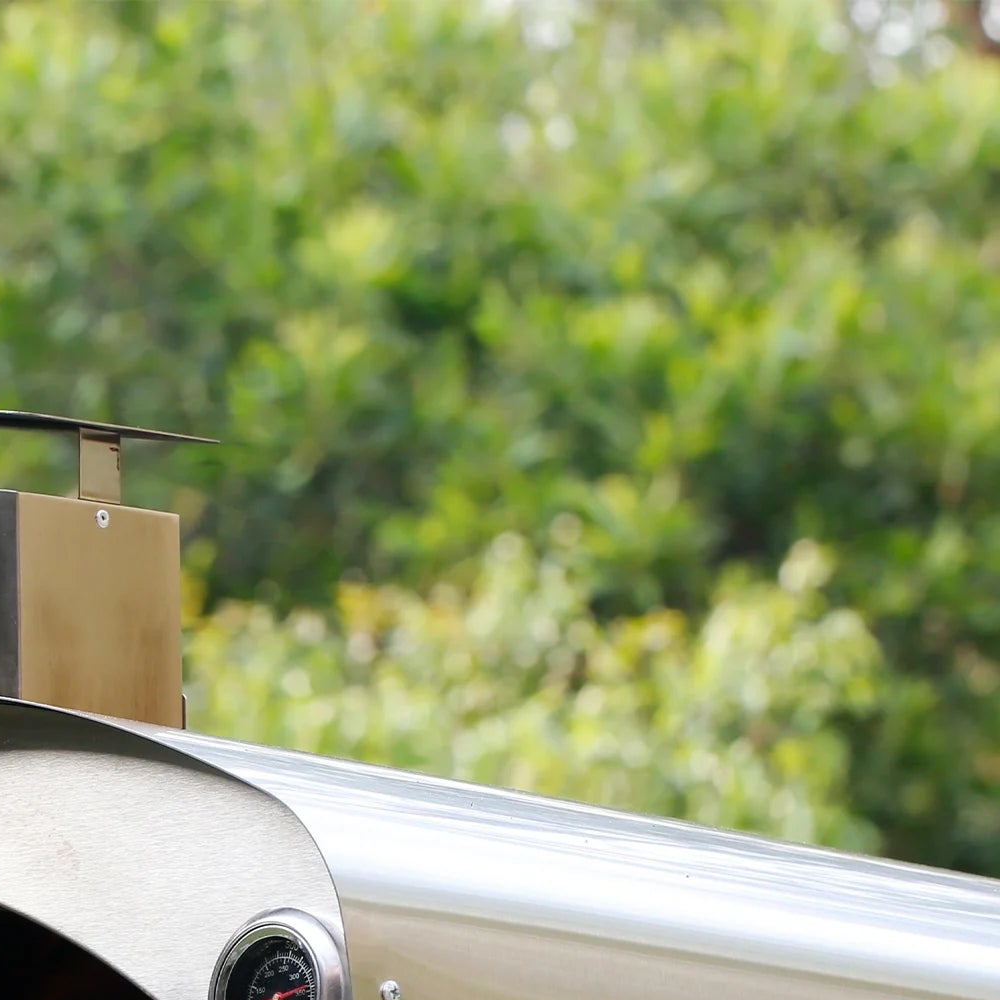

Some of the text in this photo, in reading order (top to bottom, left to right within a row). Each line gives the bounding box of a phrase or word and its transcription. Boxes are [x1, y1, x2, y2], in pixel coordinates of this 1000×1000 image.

[278, 965, 289, 974] 250
[264, 970, 275, 979] 200
[289, 973, 300, 981] 300
[256, 986, 266, 995] 150
